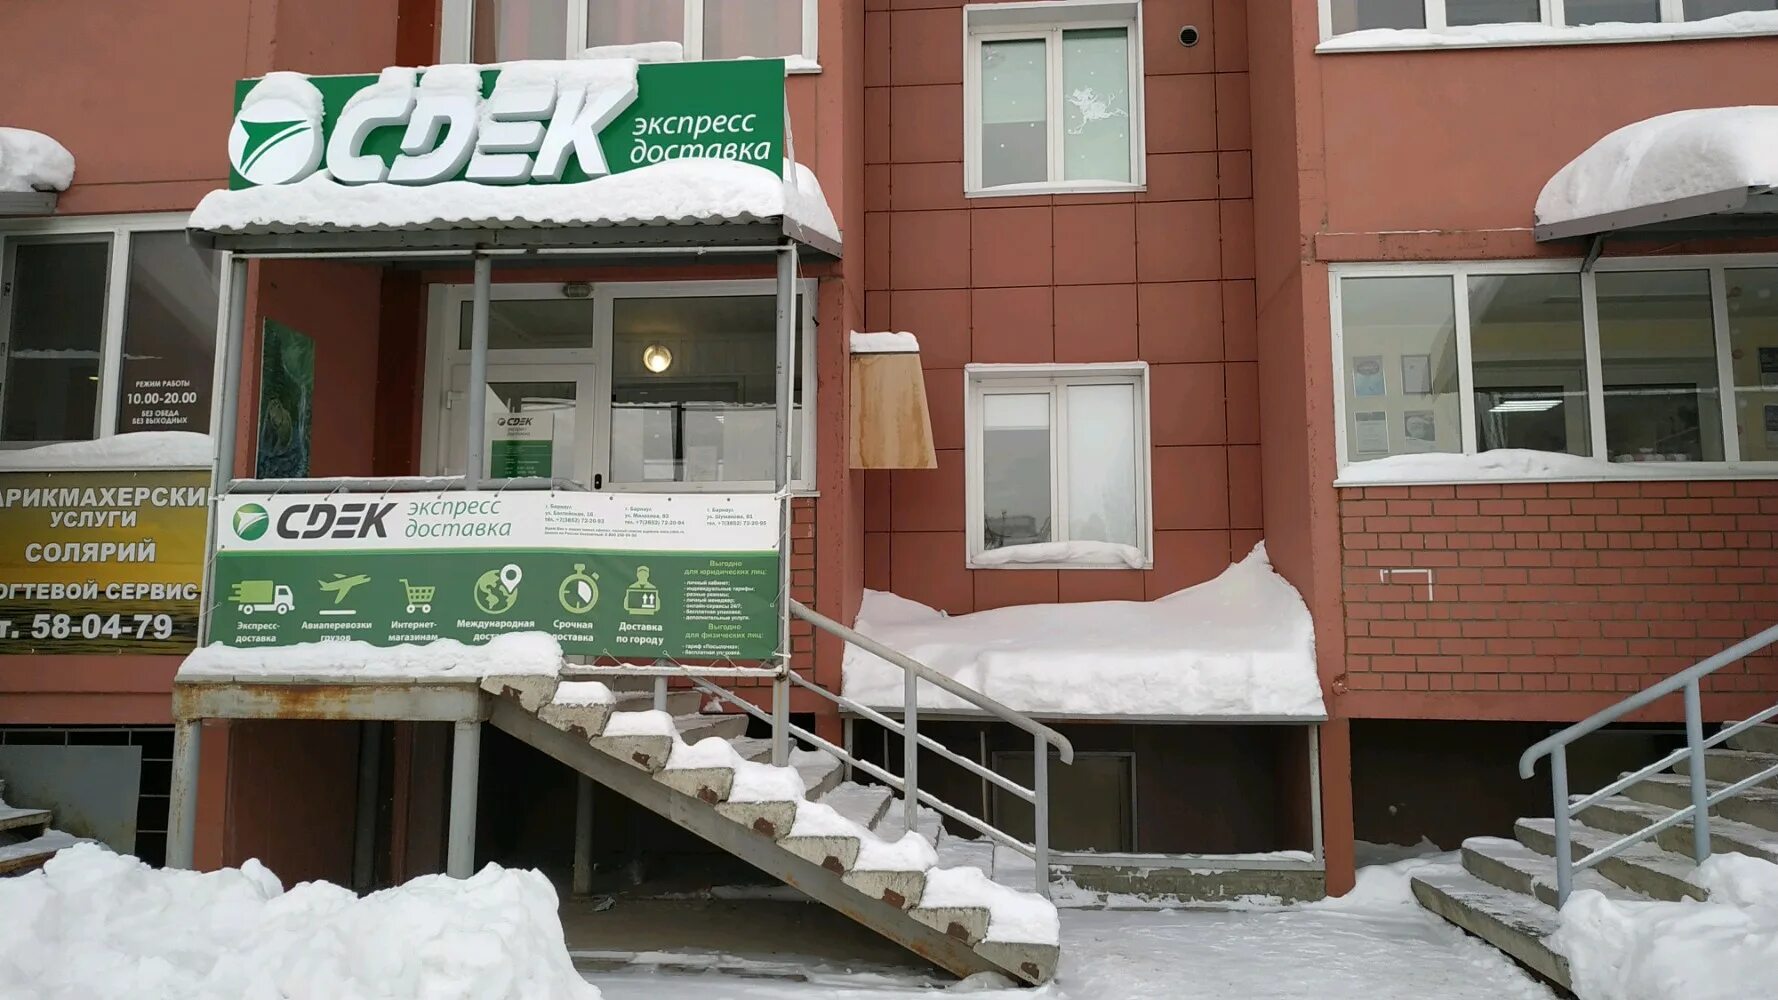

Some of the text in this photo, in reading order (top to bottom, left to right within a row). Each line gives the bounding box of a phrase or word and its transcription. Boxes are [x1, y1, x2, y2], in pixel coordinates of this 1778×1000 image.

[327, 60, 639, 182] CDEK
[632, 112, 757, 138] экспресс
[630, 139, 771, 165] доставка
[135, 380, 190, 388] РЕЖИМ РАБОТЫ
[127, 392, 197, 404] 10.00-20.00
[146, 417, 187, 425] ВЫХОДНЫХ
[507, 417, 533, 426] CDEK
[0, 487, 210, 507] РИКМАХЕРСКИ
[408, 500, 501, 519] экспресс
[50, 511, 137, 528] УСЛУГИ
[276, 502, 398, 539] CDEK
[405, 519, 512, 538] доставка
[25, 538, 156, 563] СОЛЯРИЙ
[105, 583, 198, 600] СЕРВИС
[31, 613, 173, 639] 58-04-79
[237, 622, 281, 632] Экспресс-
[301, 622, 373, 633] Авиаперевозки
[391, 620, 438, 631] Интернет-
[457, 619, 535, 629] Международная
[553, 620, 593, 630] Срочная
[619, 622, 663, 632] Доставка
[235, 633, 277, 644] доставка
[388, 634, 438, 642] магазинам
[616, 635, 664, 645] по городу
